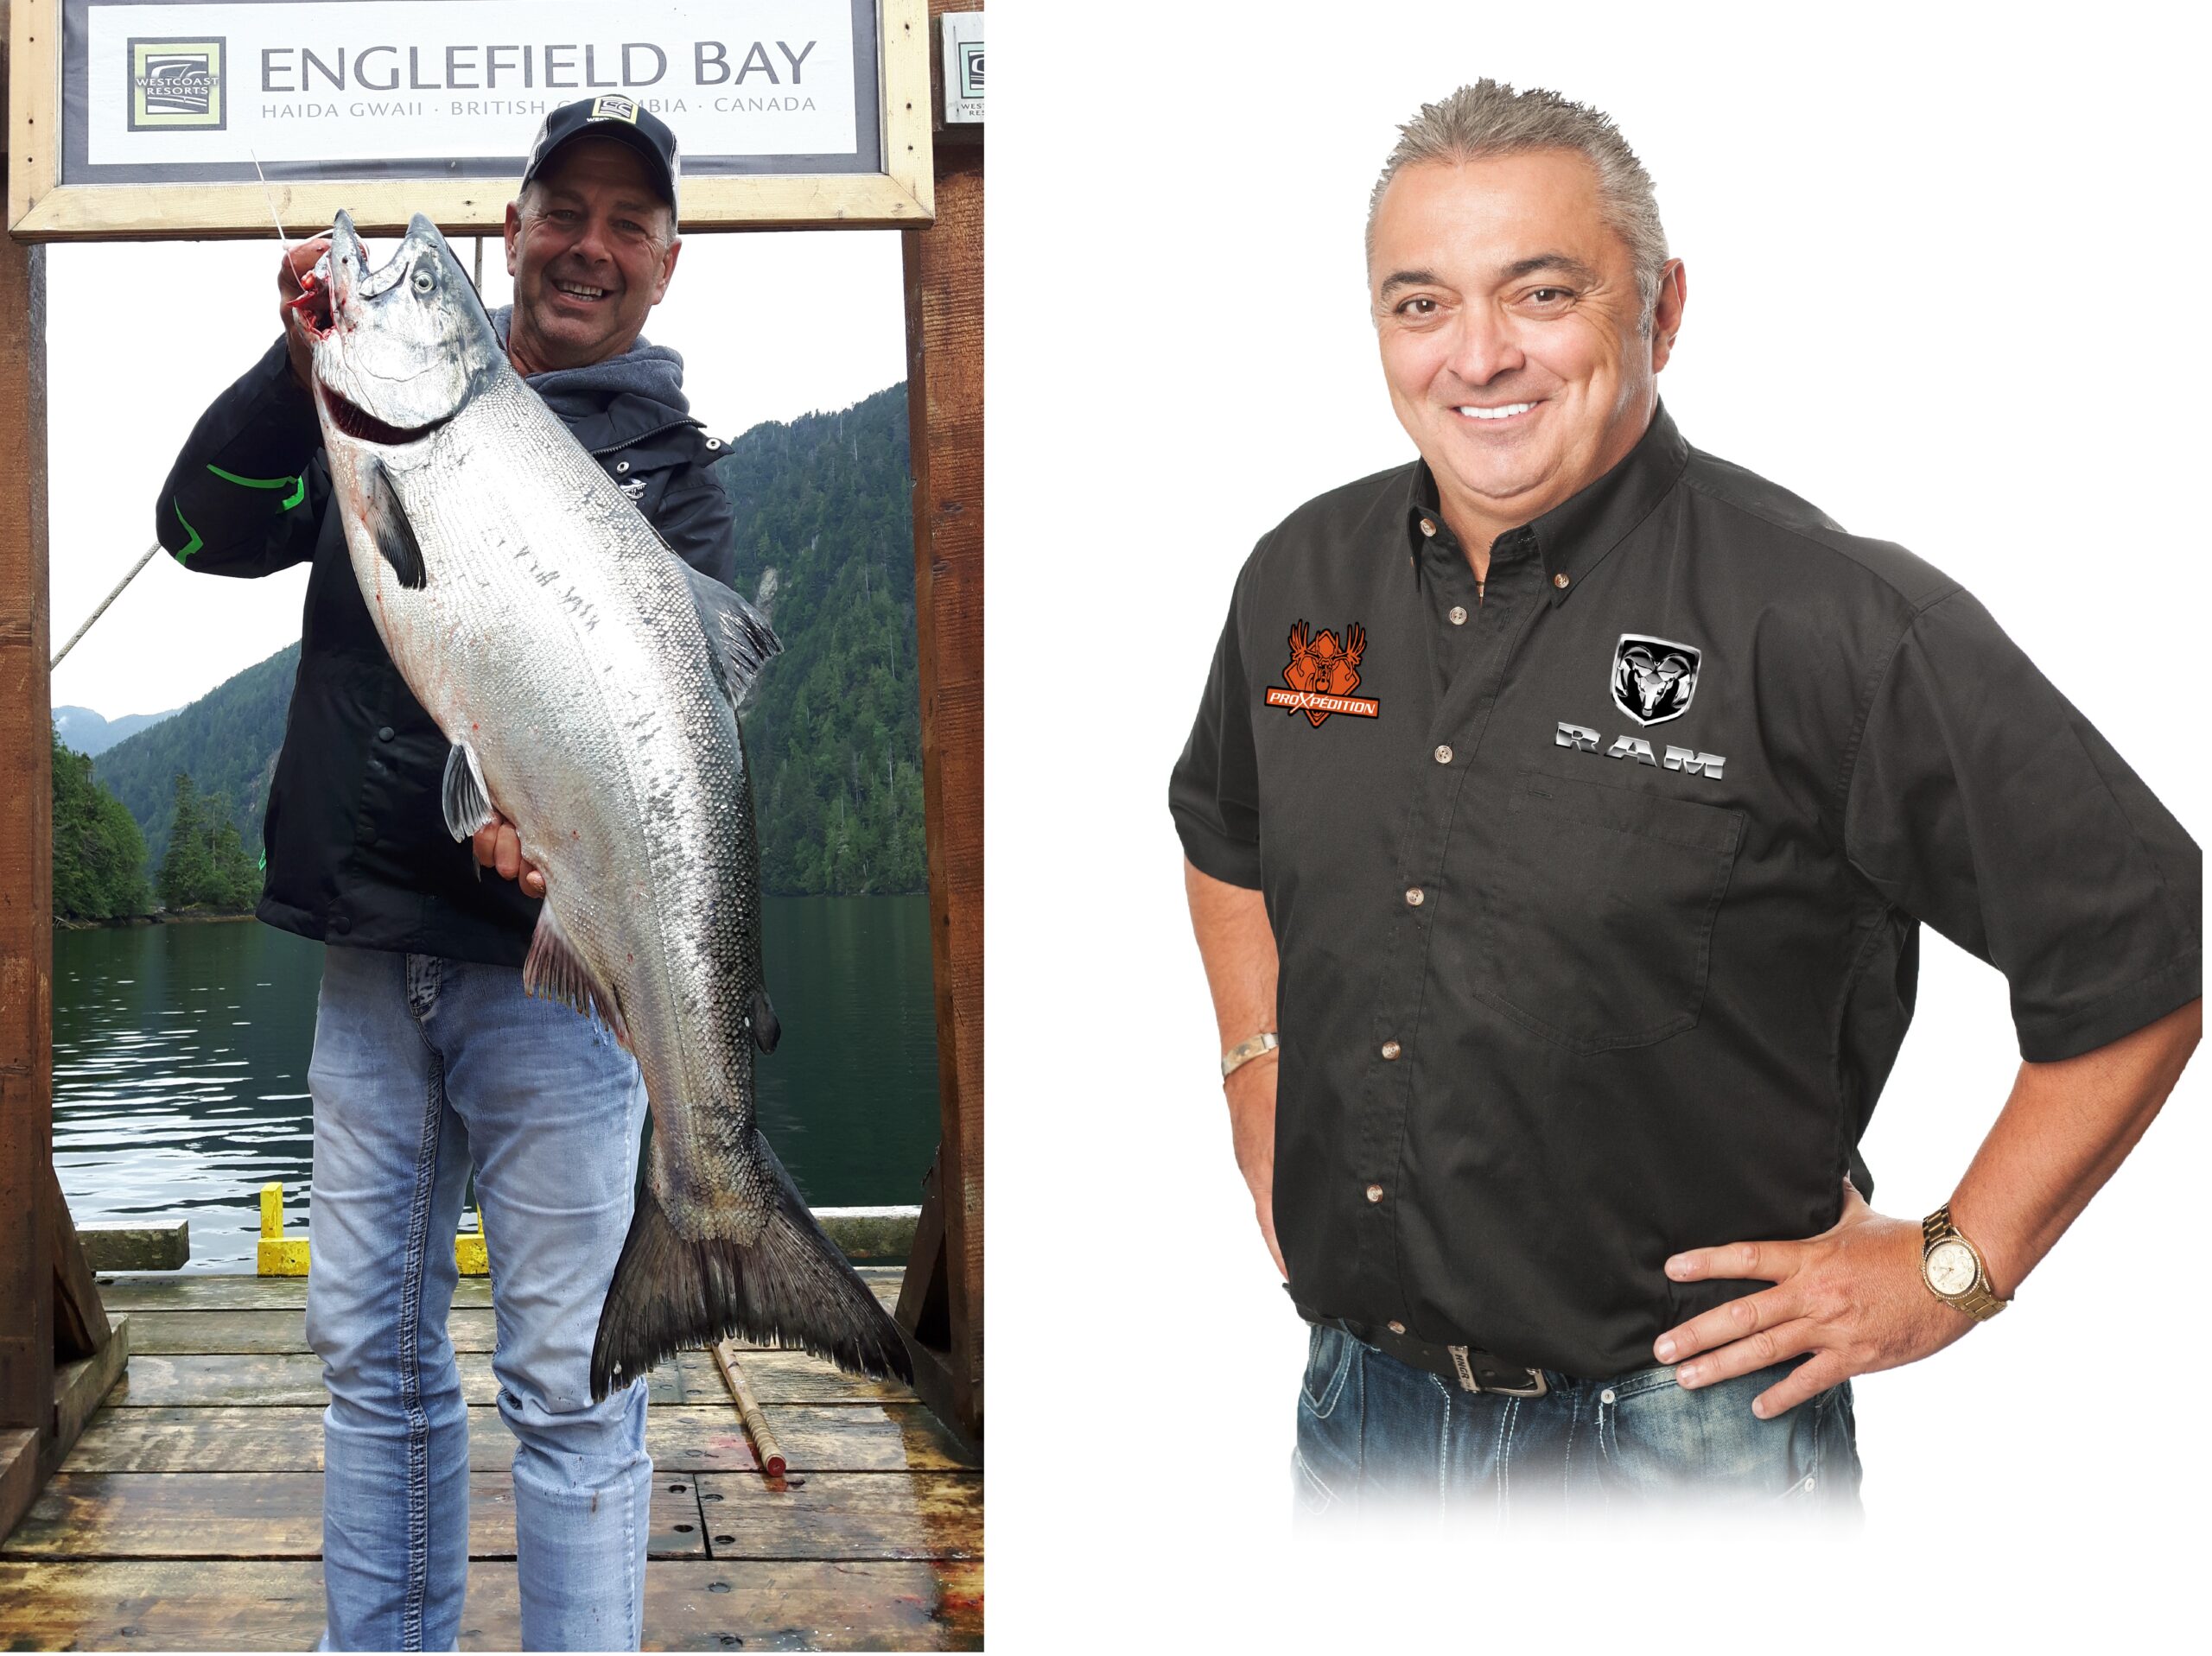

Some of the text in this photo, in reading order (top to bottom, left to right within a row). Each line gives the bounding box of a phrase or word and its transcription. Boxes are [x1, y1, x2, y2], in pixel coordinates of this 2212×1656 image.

[262, 41, 817, 92] ENGLEFIELD BAY
[136, 77, 219, 86] WESTCOAST
[146, 86, 208, 95] RESORTS
[262, 103, 339, 118] HAIDA
[349, 102, 423, 117] GWAII
[451, 100, 545, 116] BRITISH
[714, 97, 817, 112] CANADA
[1555, 721, 1726, 780] RAM
